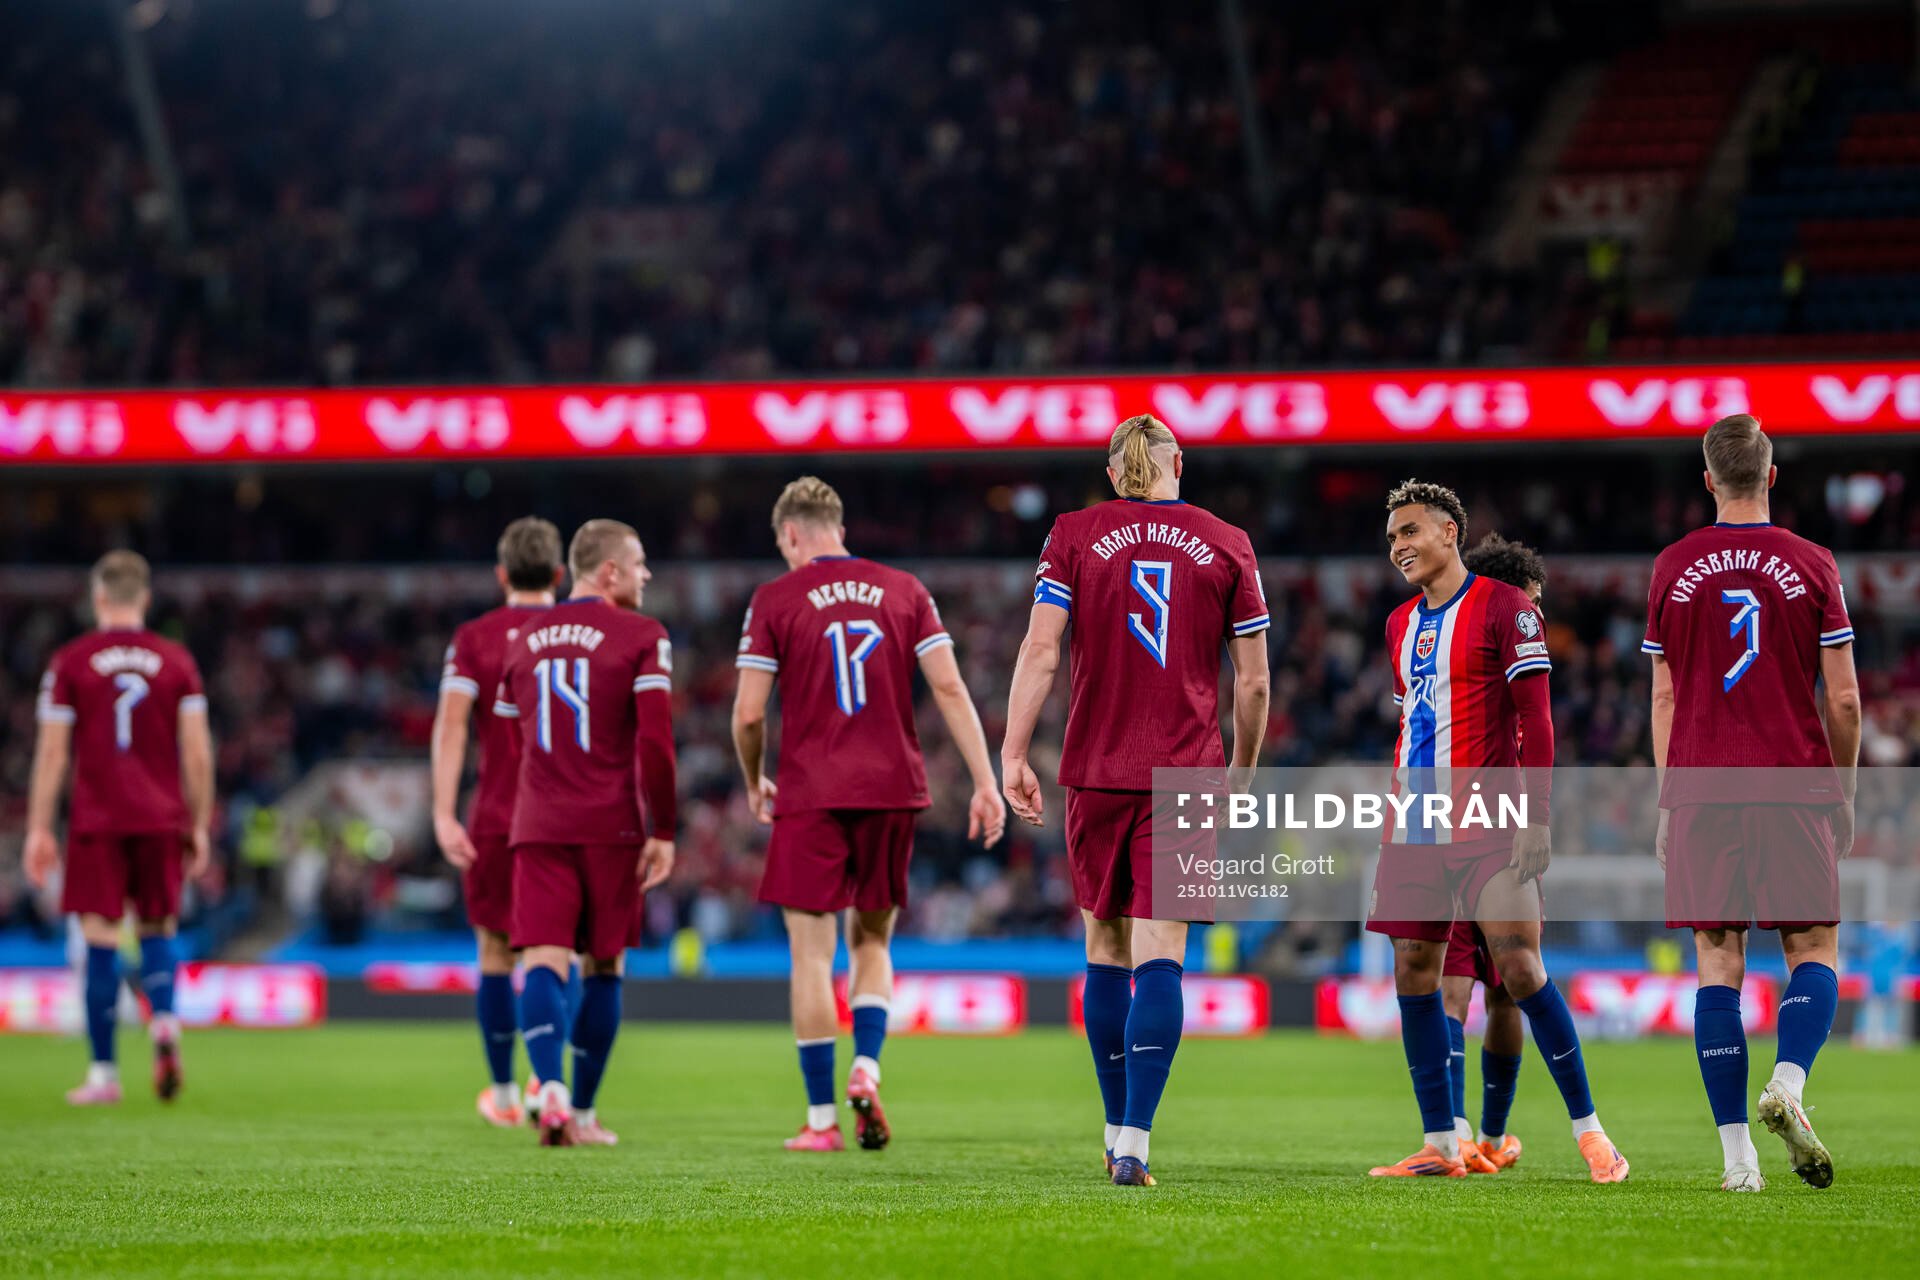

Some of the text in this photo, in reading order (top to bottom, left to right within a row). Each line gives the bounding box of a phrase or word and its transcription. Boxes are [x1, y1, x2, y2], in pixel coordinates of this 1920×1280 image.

[174, 399, 316, 453] VG
[366, 397, 511, 450] VG
[559, 393, 707, 447] VG
[754, 390, 910, 444] VG
[950, 385, 1118, 443] VG
[1152, 382, 1328, 438] VG
[1373, 380, 1530, 431] VG
[1589, 377, 1749, 427] VG
[1091, 522, 1215, 566] BRAUT HAALAND
[1671, 549, 1762, 603] VASSBAKK
[1761, 555, 1807, 601] AJER
[807, 580, 885, 611] HEGGEM
[1127, 560, 1173, 669] 9
[823, 619, 885, 717] 17
[533, 657, 591, 754] 14
[1702, 1046, 1741, 1058] NORGE
